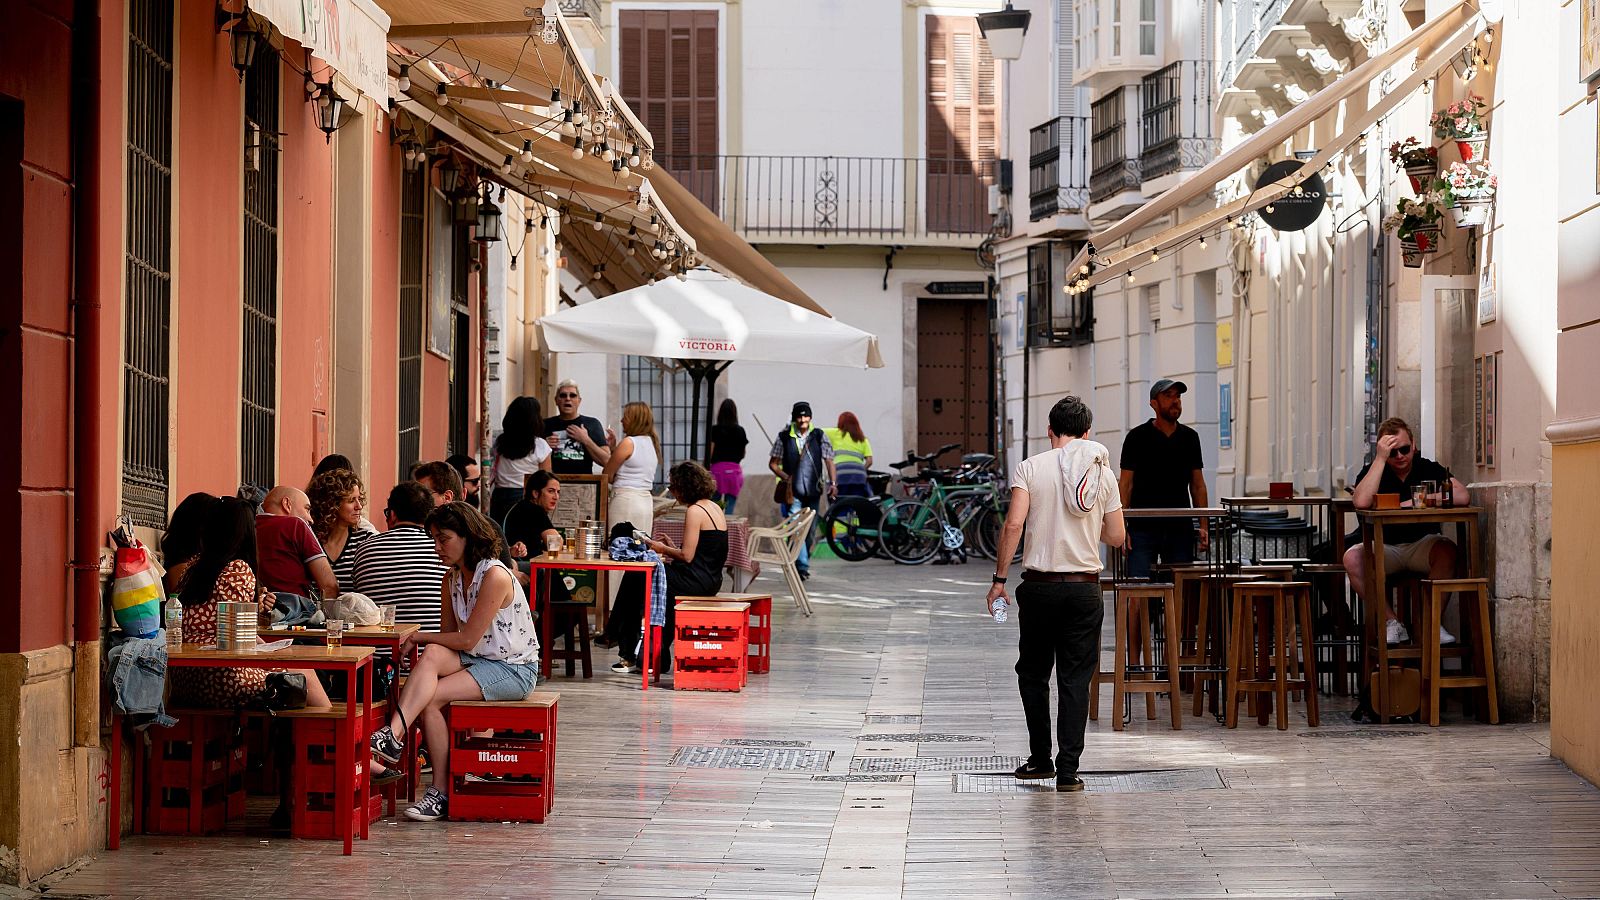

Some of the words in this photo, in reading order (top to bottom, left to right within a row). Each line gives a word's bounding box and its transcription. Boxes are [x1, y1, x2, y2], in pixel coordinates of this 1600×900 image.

[679, 341, 737, 351] VICTORIA
[693, 641, 722, 650] Mahou
[478, 751, 518, 762] Mahou
